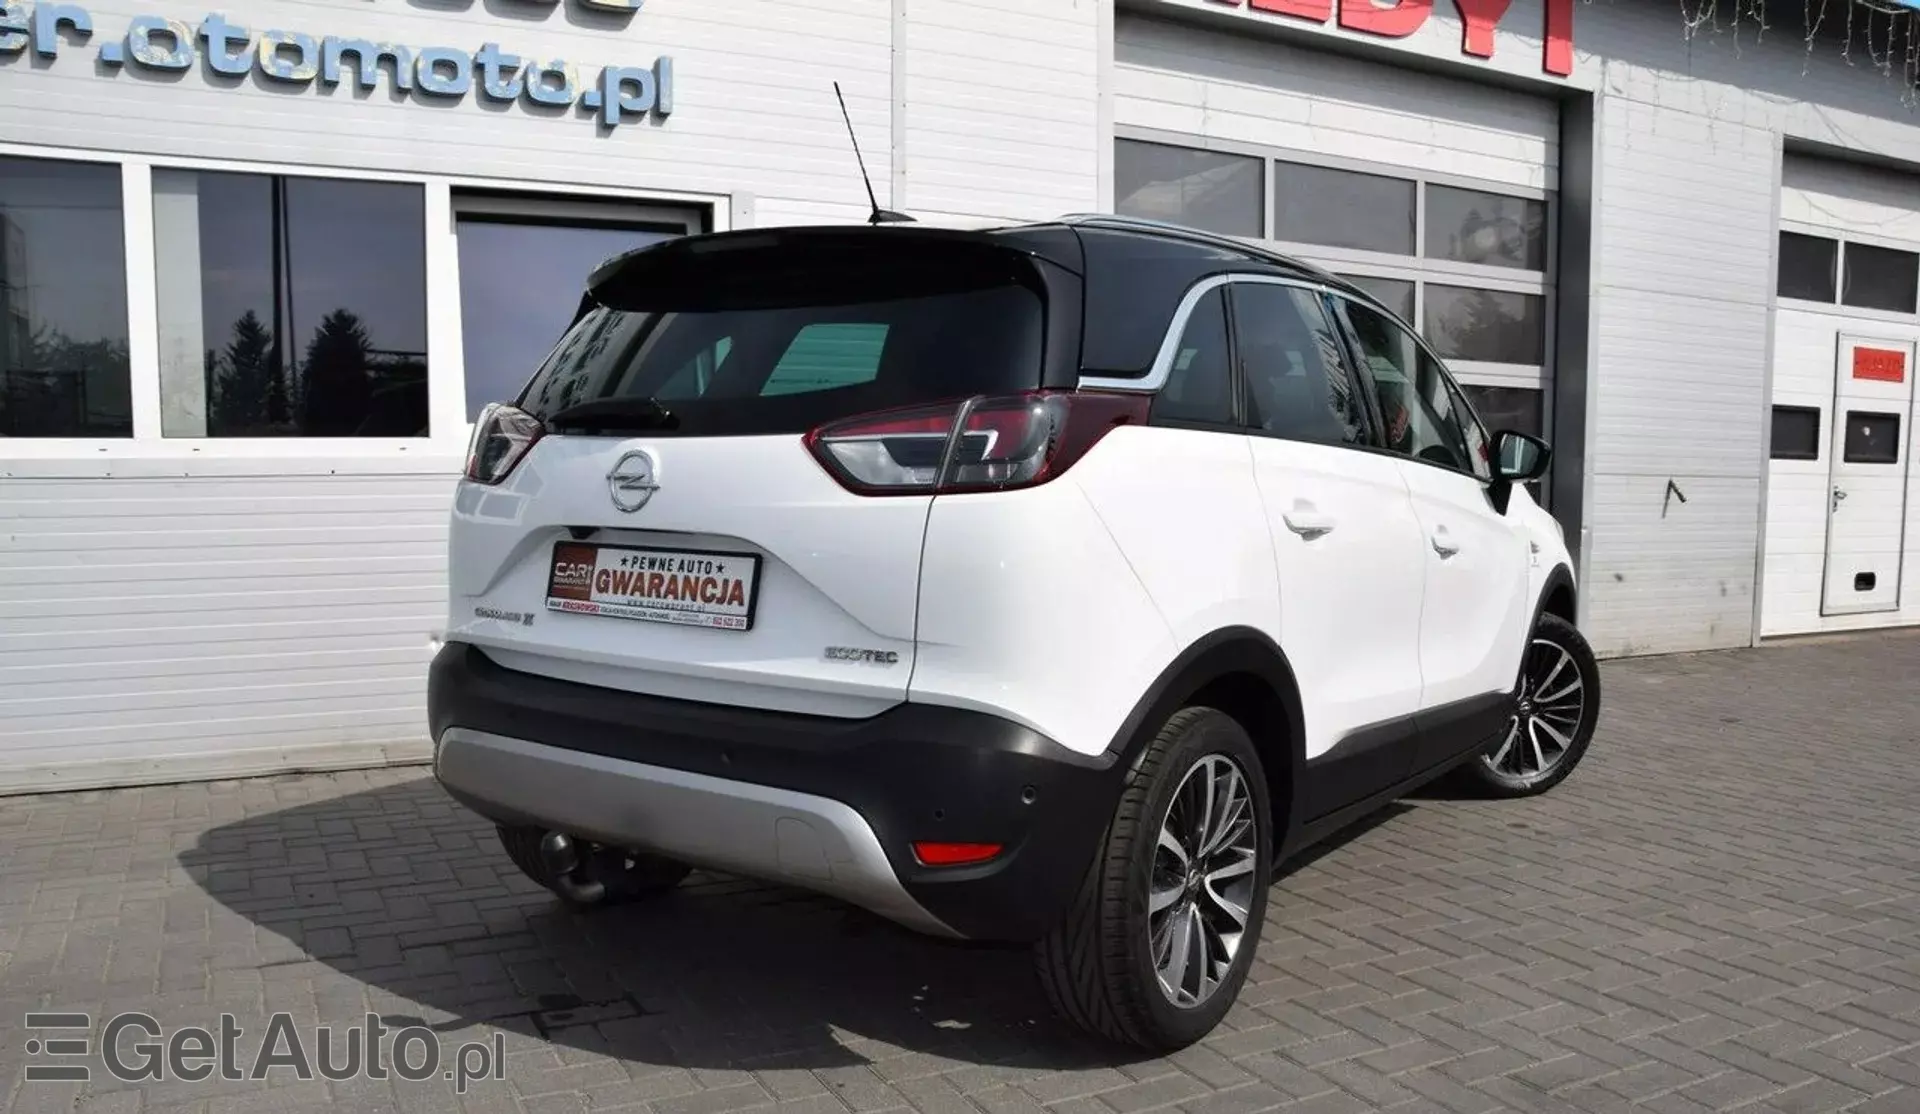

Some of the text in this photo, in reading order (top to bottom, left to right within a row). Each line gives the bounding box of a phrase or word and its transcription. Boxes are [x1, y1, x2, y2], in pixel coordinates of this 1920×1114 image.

[631, 556, 713, 575] PEWNE AUTO
[595, 568, 745, 607] GWARANCJA
[824, 646, 899, 663] ECOTEC
